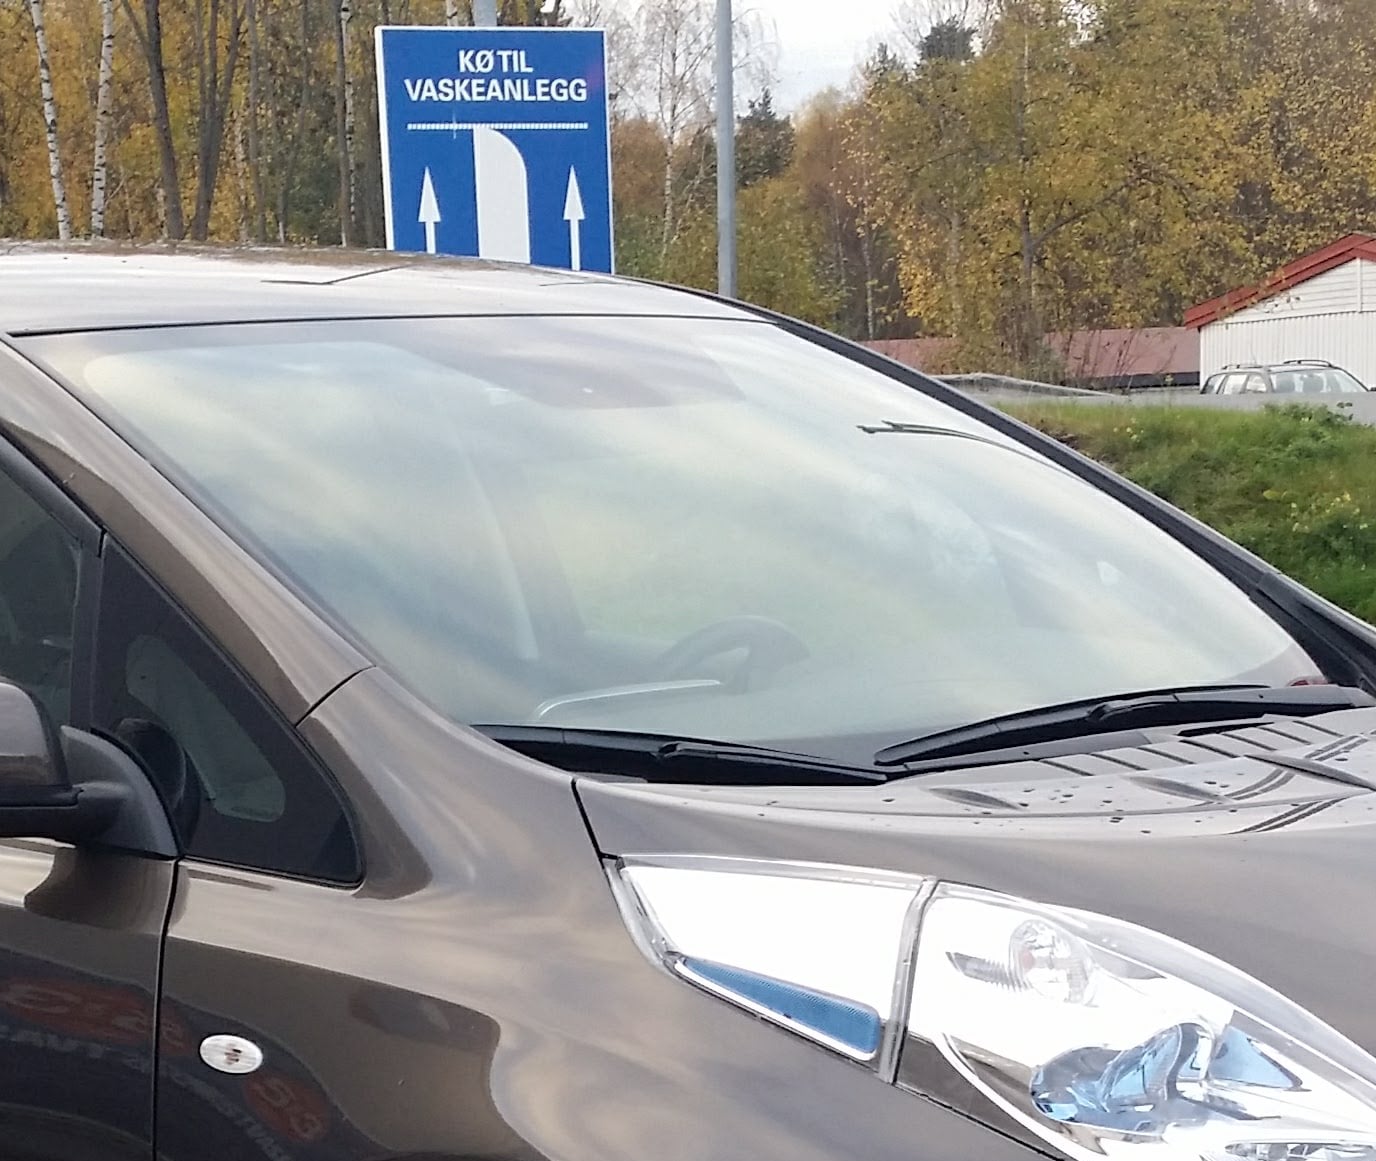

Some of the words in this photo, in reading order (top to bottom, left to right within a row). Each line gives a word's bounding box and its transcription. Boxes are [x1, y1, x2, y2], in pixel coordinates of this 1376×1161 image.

[459, 49, 494, 73] KØ
[497, 50, 534, 73] TIL
[404, 78, 587, 102] VASKEANLEGG
